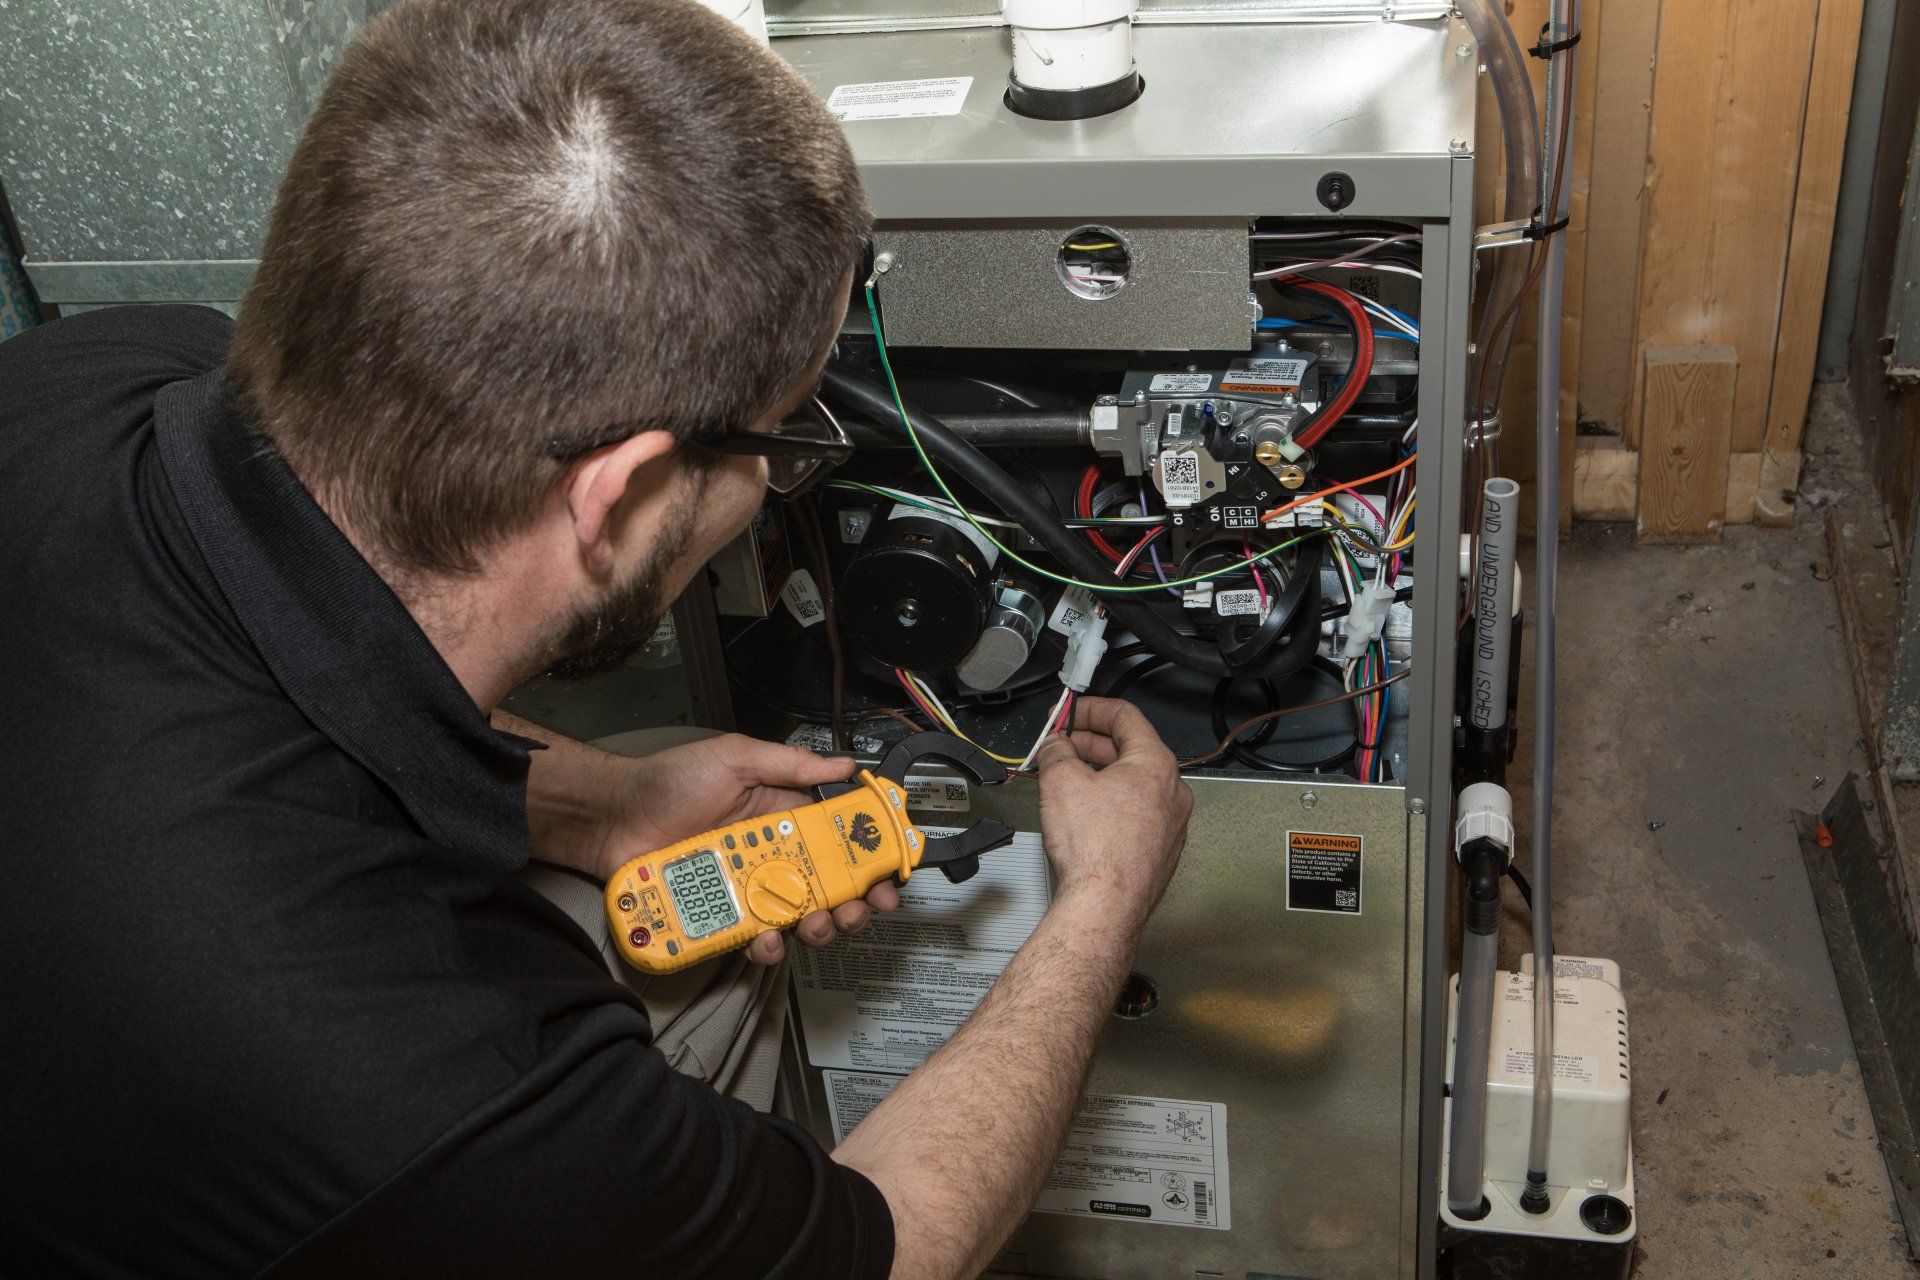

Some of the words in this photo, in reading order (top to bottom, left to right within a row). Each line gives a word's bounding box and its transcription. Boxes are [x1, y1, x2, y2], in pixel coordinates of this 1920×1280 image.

[1228, 465, 1240, 476] HI
[1256, 491, 1268, 500] LO
[1210, 506, 1220, 522] ON
[1484, 498, 1502, 533] AND
[1478, 543, 1498, 660] UNDERGROUND
[1302, 838, 1358, 848] WARNING
